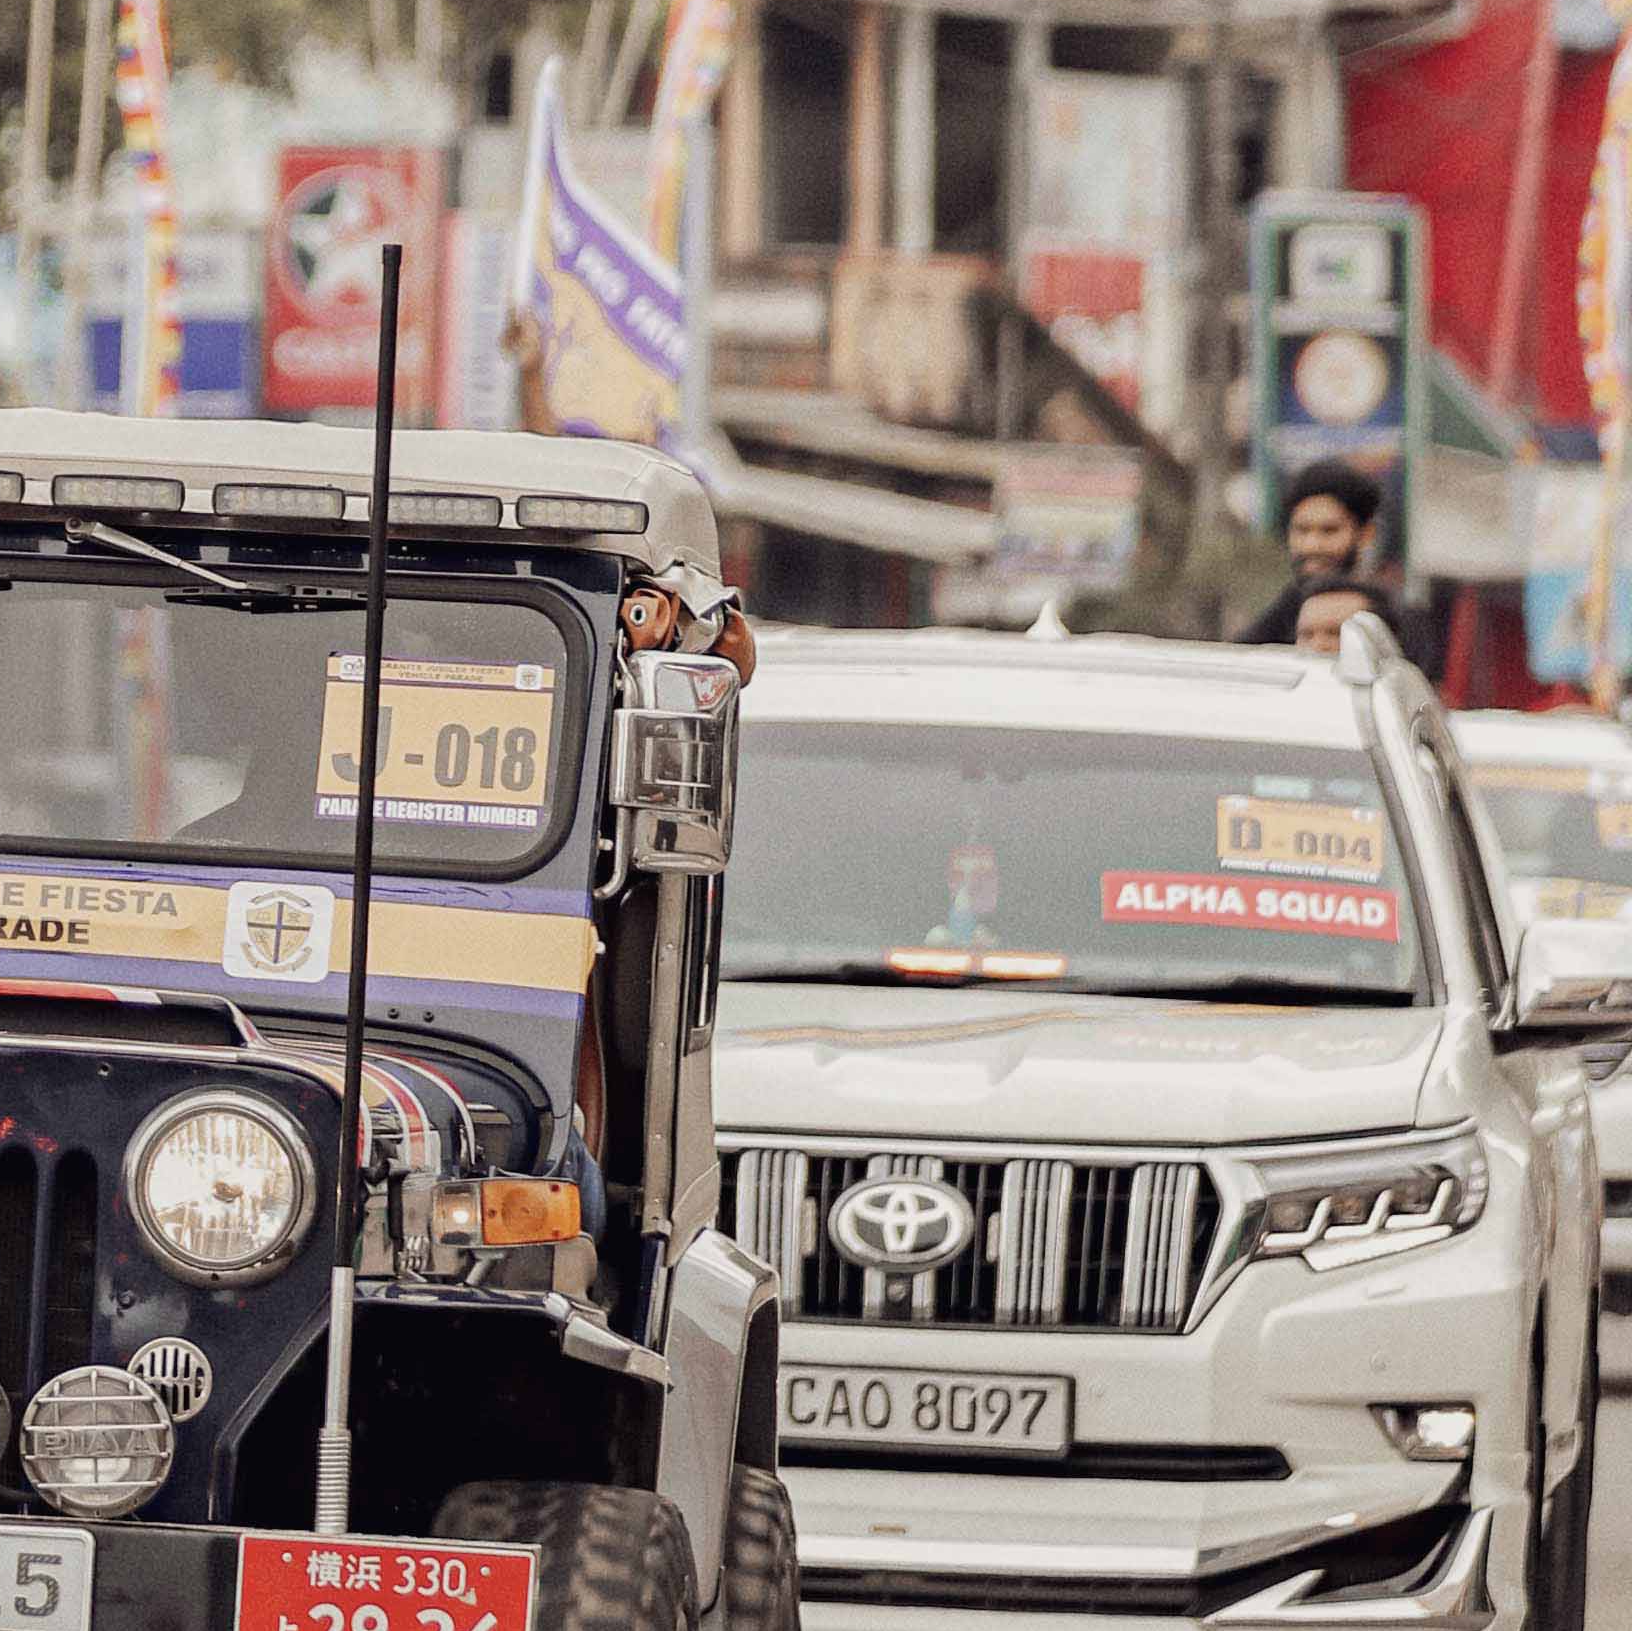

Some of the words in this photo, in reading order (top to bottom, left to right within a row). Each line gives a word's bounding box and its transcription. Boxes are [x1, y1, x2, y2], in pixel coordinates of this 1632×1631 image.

[319, 798, 384, 817] PARAE
[385, 800, 465, 822] REGISTER
[467, 805, 537, 827] NUMBER
[40, 884, 180, 917] FIESTA
[1117, 881, 1246, 917] ALPHA
[1256, 888, 1389, 929] SQUAD
[787, 1376, 892, 1429] CAO
[913, 1382, 1048, 1436] 8097
[34, 1428, 162, 1457] PIAA
[306, 1549, 383, 1592] 横浜
[392, 1555, 467, 1598] 330
